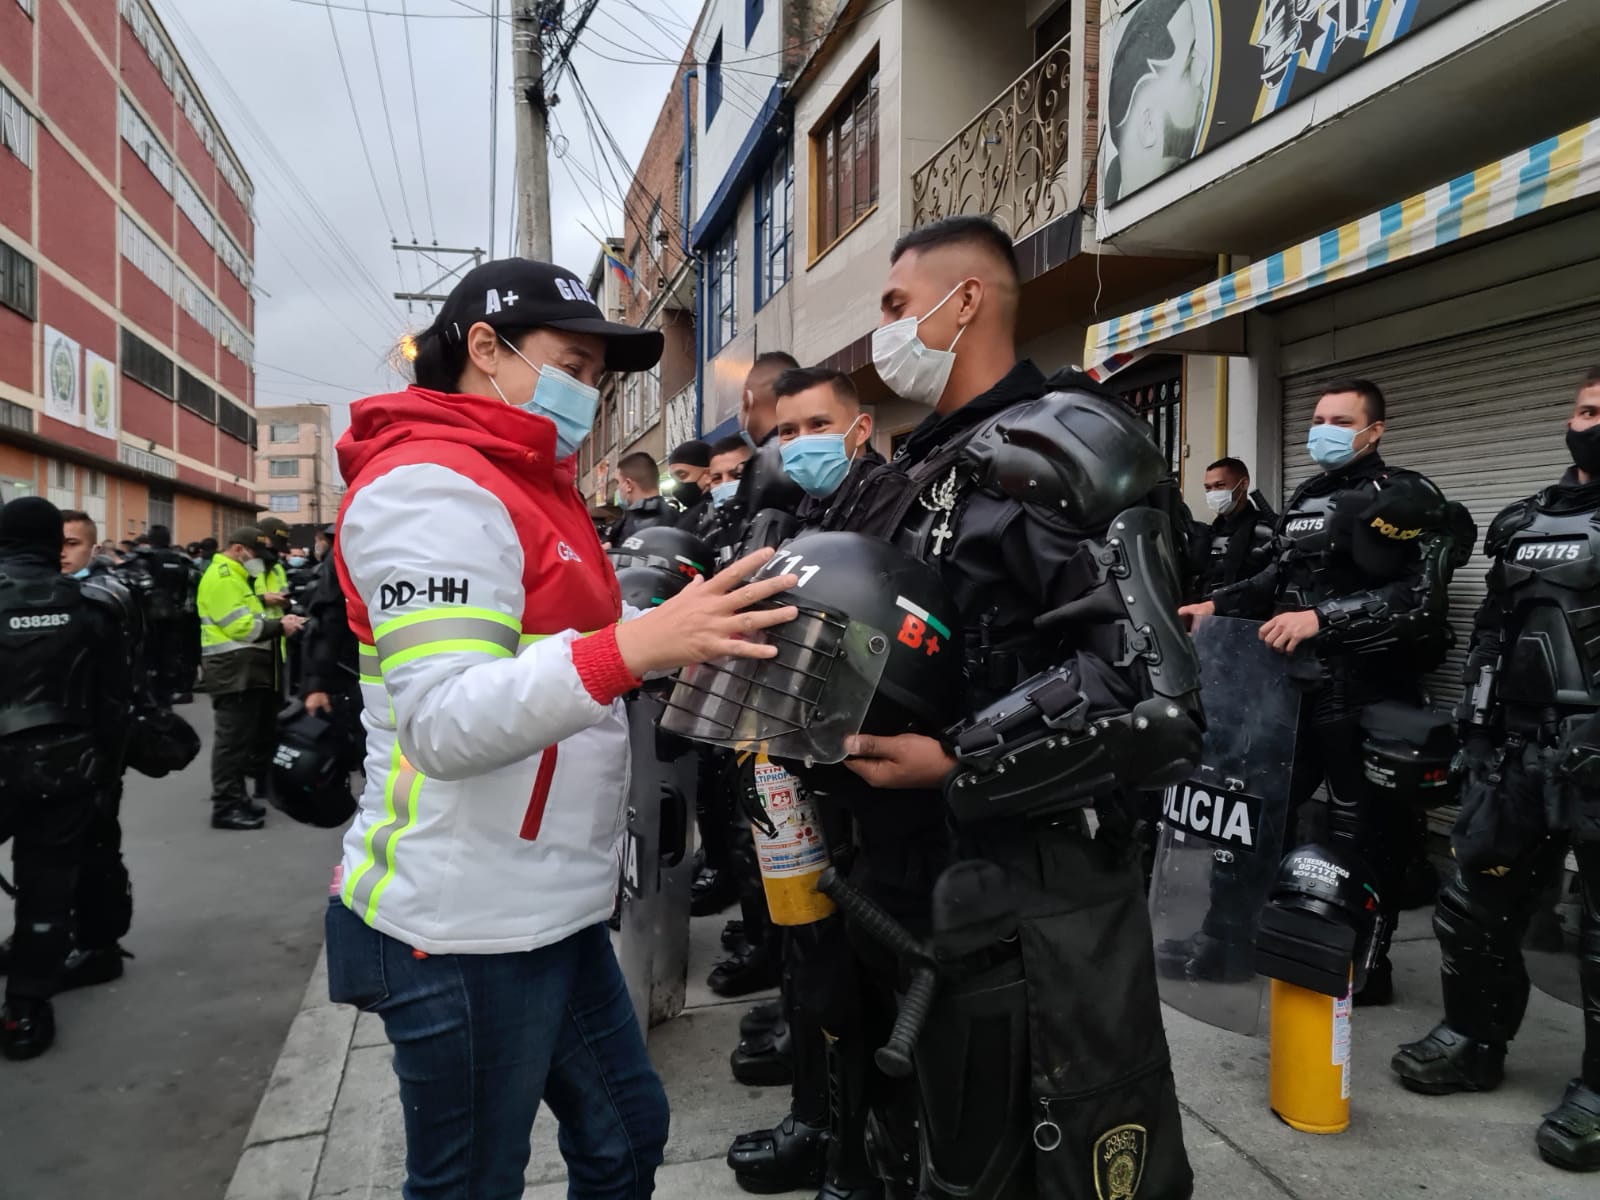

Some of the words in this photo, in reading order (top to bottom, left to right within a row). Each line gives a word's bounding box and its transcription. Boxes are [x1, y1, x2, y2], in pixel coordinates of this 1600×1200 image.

[485, 288, 519, 315] A+
[1516, 544, 1581, 561] 057175
[380, 577, 468, 610] DD-HH
[9, 613, 71, 629] 038283
[897, 613, 941, 656] B+
